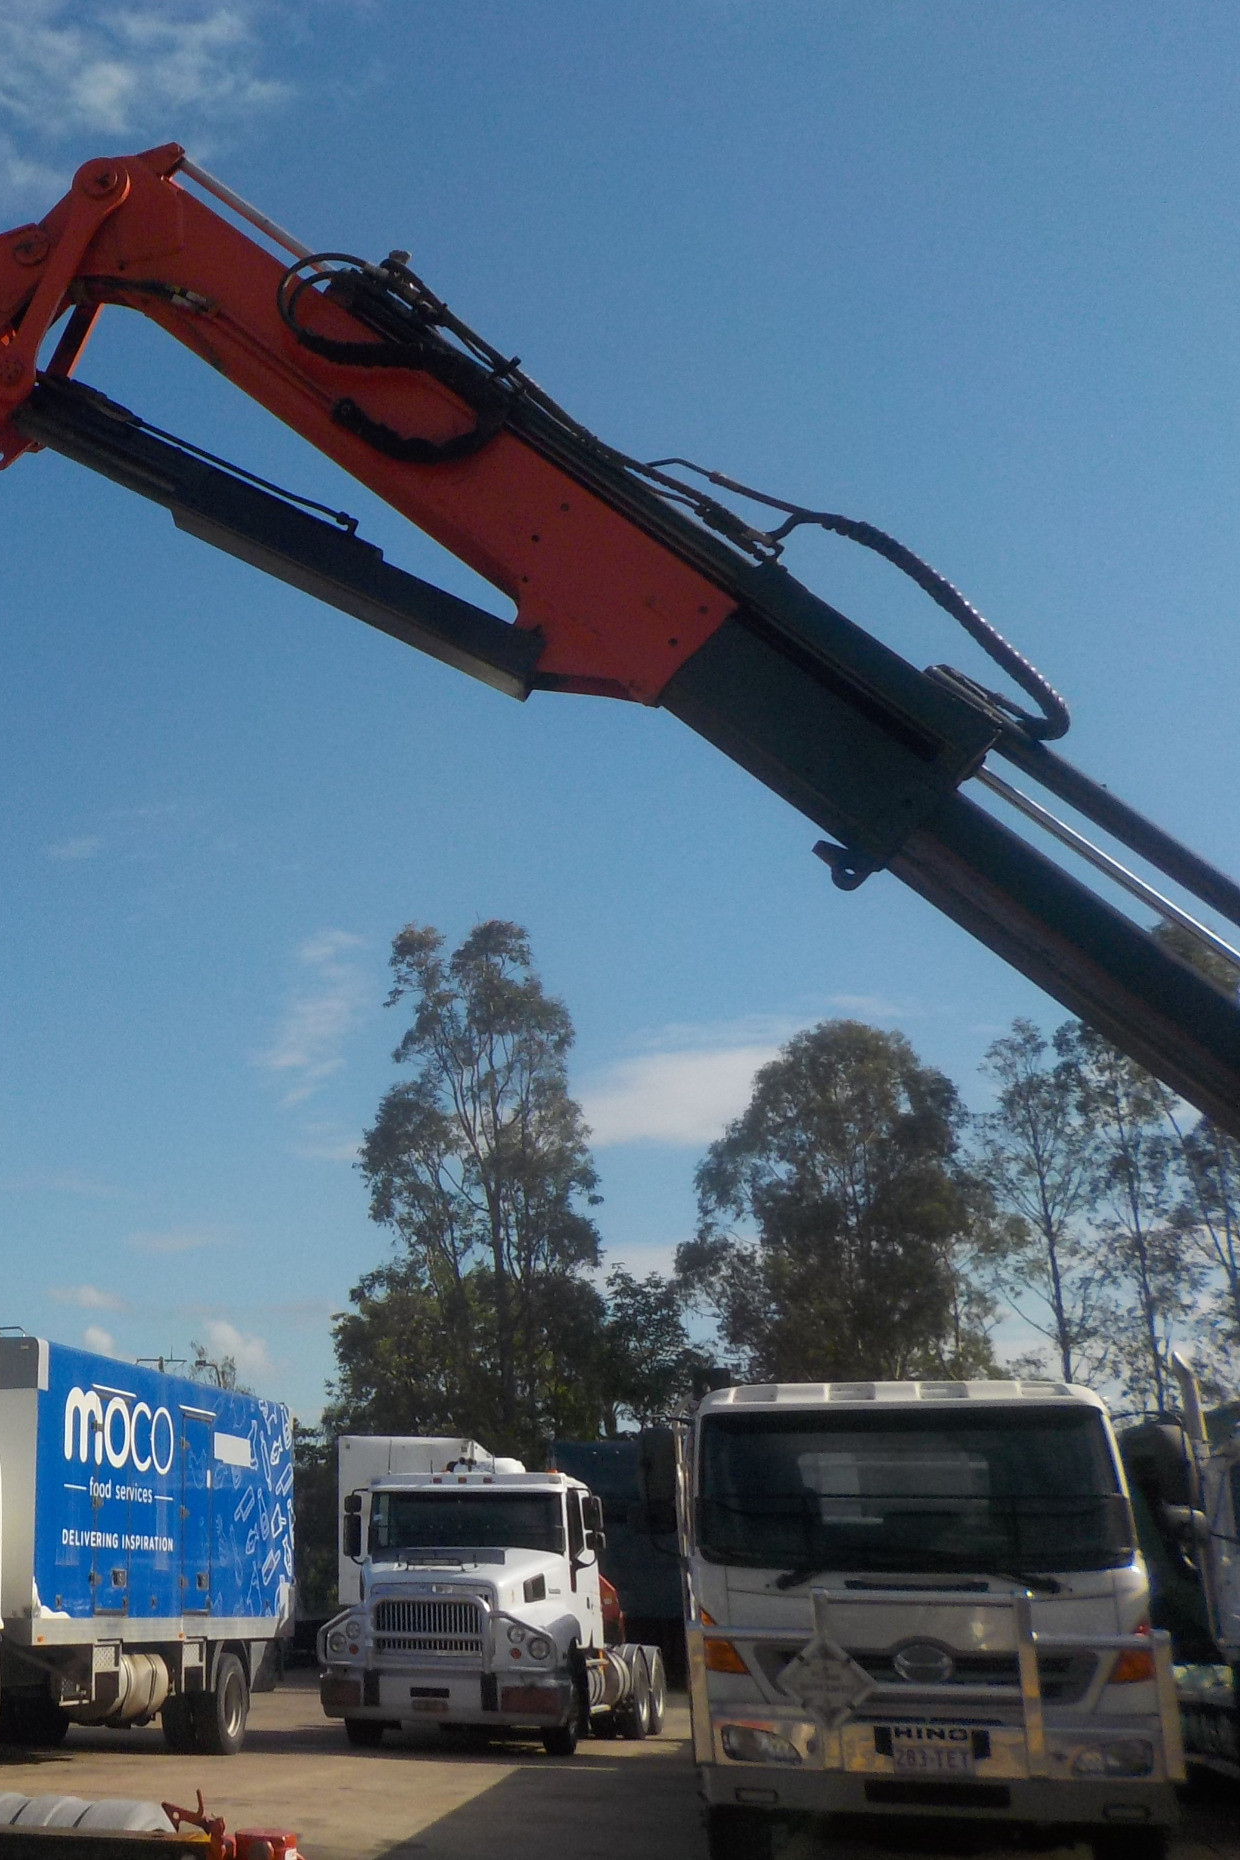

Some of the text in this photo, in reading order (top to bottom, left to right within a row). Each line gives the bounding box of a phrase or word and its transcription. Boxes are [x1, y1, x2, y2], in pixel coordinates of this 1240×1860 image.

[89, 1476, 153, 1504] food services
[62, 1528, 174, 1552] DELIVERING INSPIRATION
[894, 1726, 968, 1741] HINO
